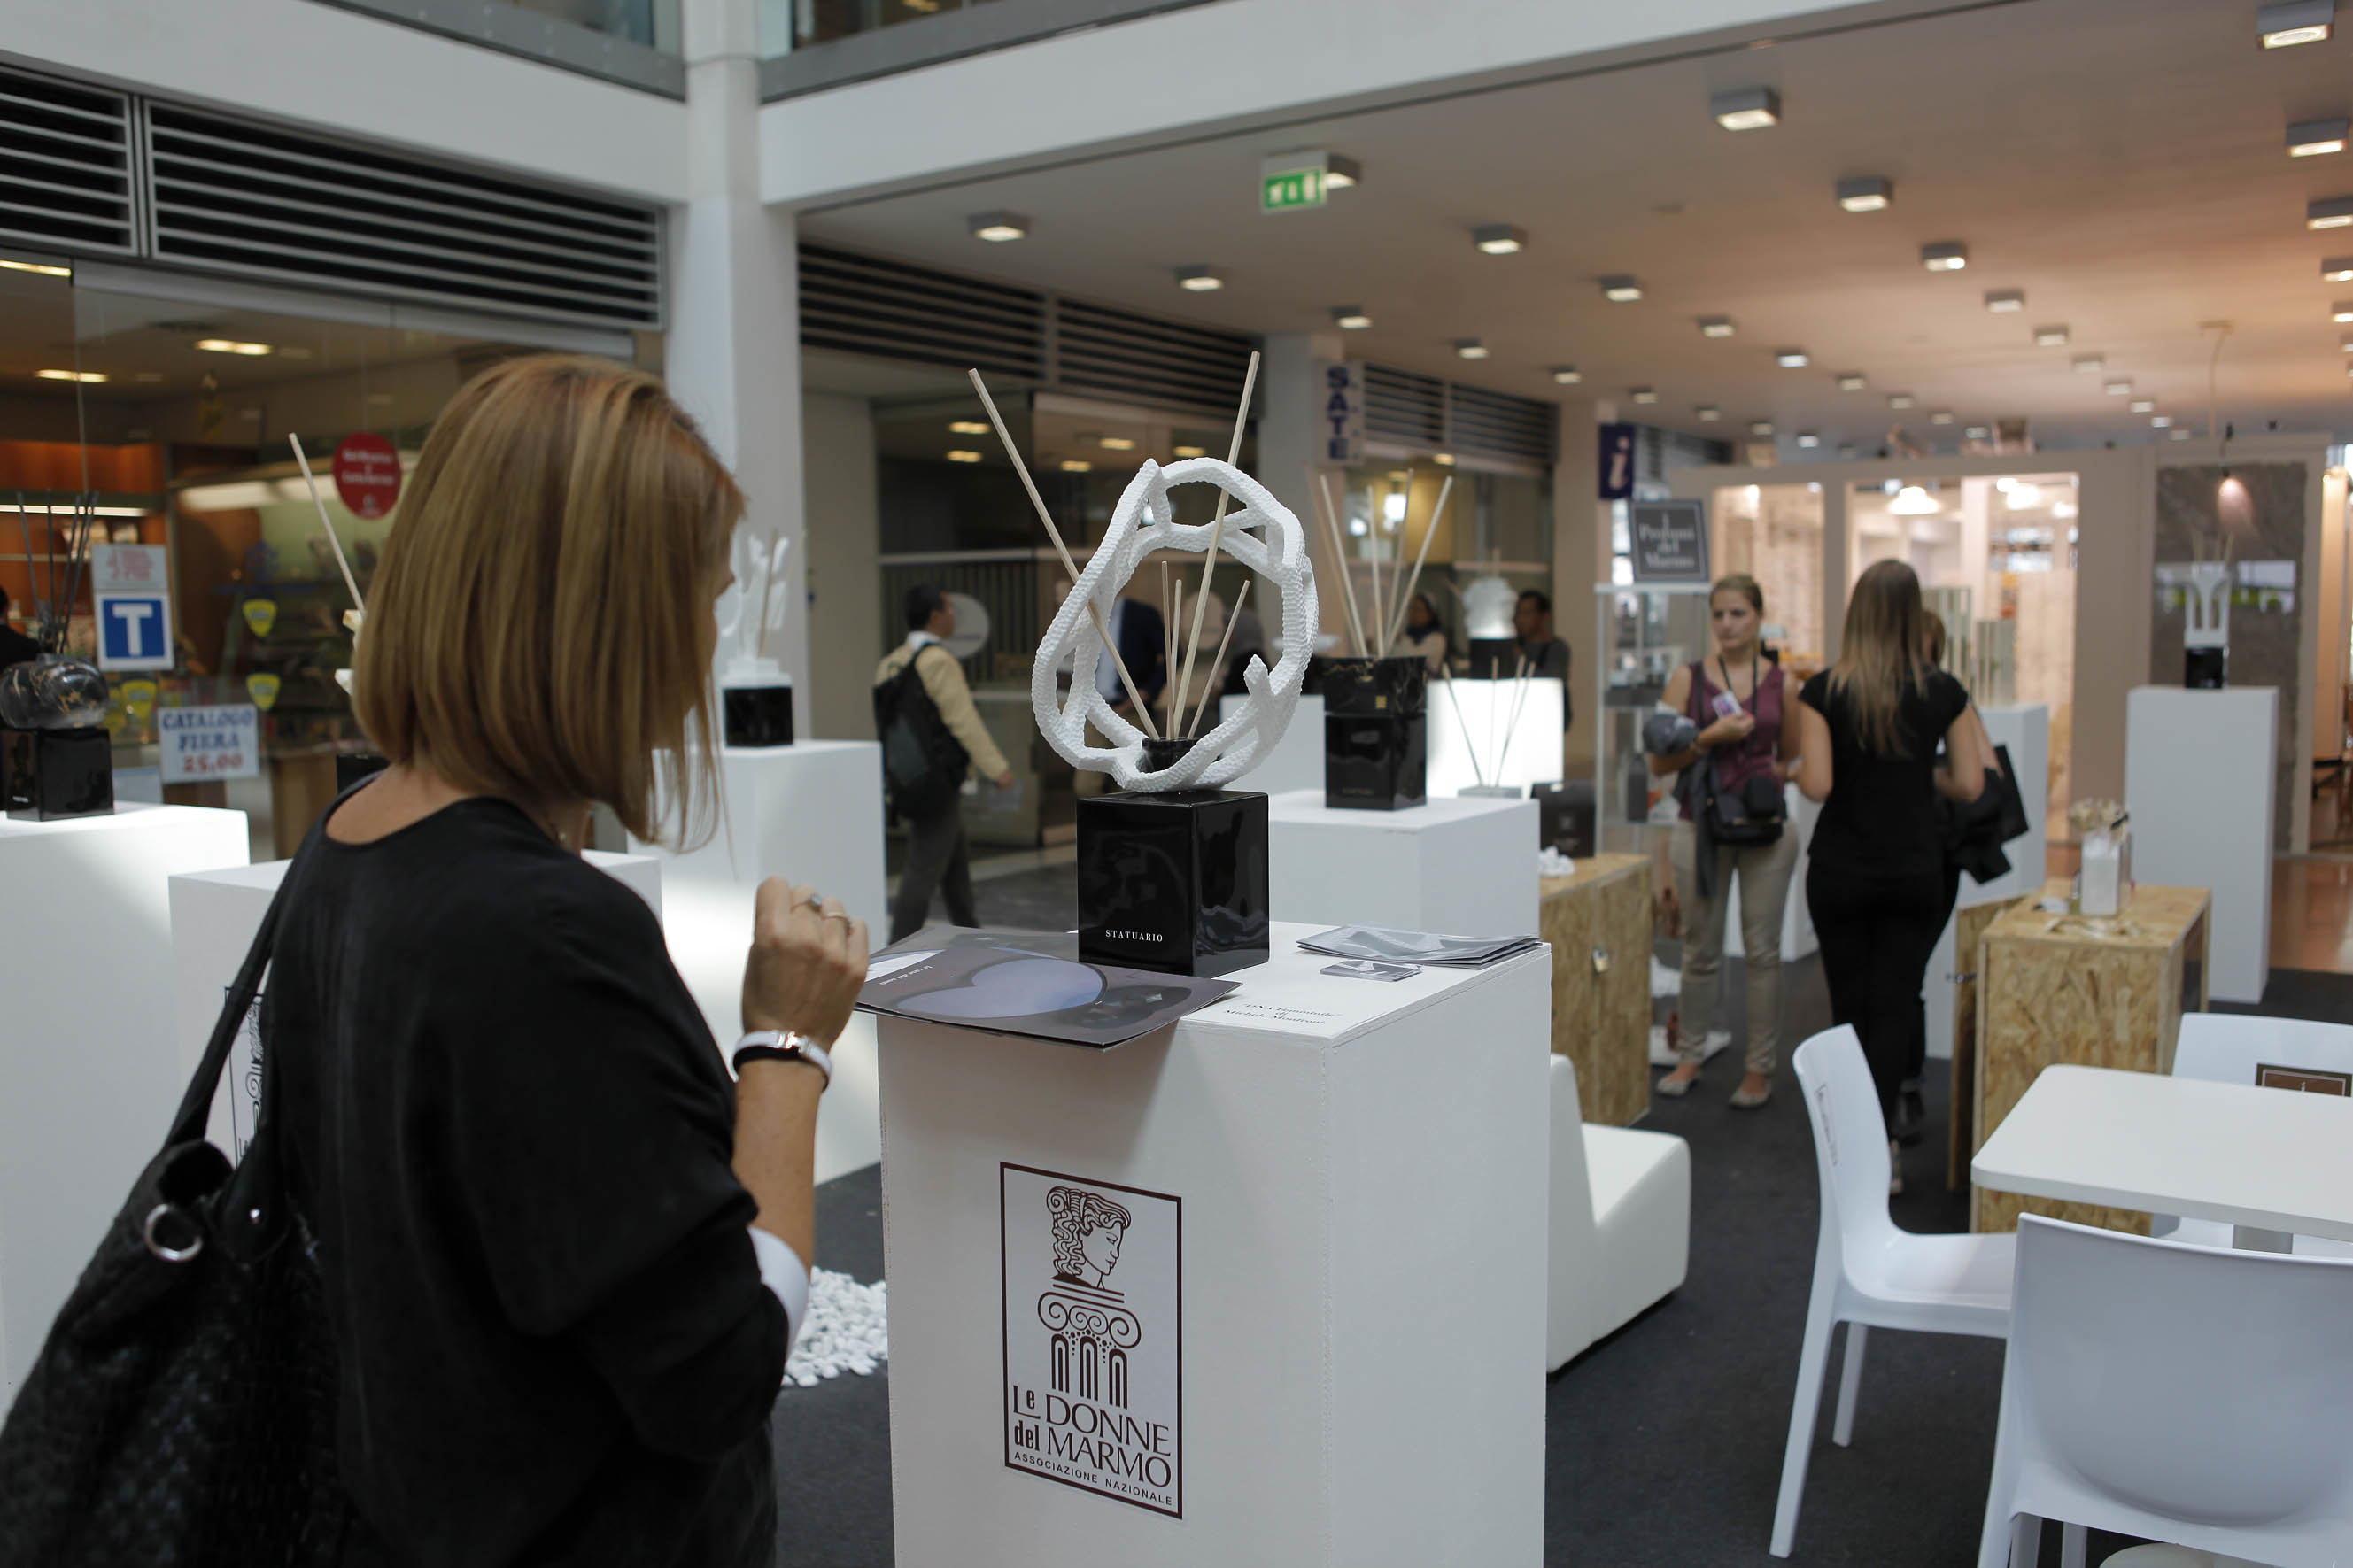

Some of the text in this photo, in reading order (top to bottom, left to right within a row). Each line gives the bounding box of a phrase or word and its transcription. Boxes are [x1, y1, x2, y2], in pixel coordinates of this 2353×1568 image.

[112, 603, 153, 656] T
[1105, 929, 1163, 942] STATUARIO
[1013, 1385, 1172, 1457] Le DONNE
[1014, 1419, 1173, 1488] del MARMO
[1014, 1451, 1173, 1506] ASSOCIAZIONE NAZIONALE
